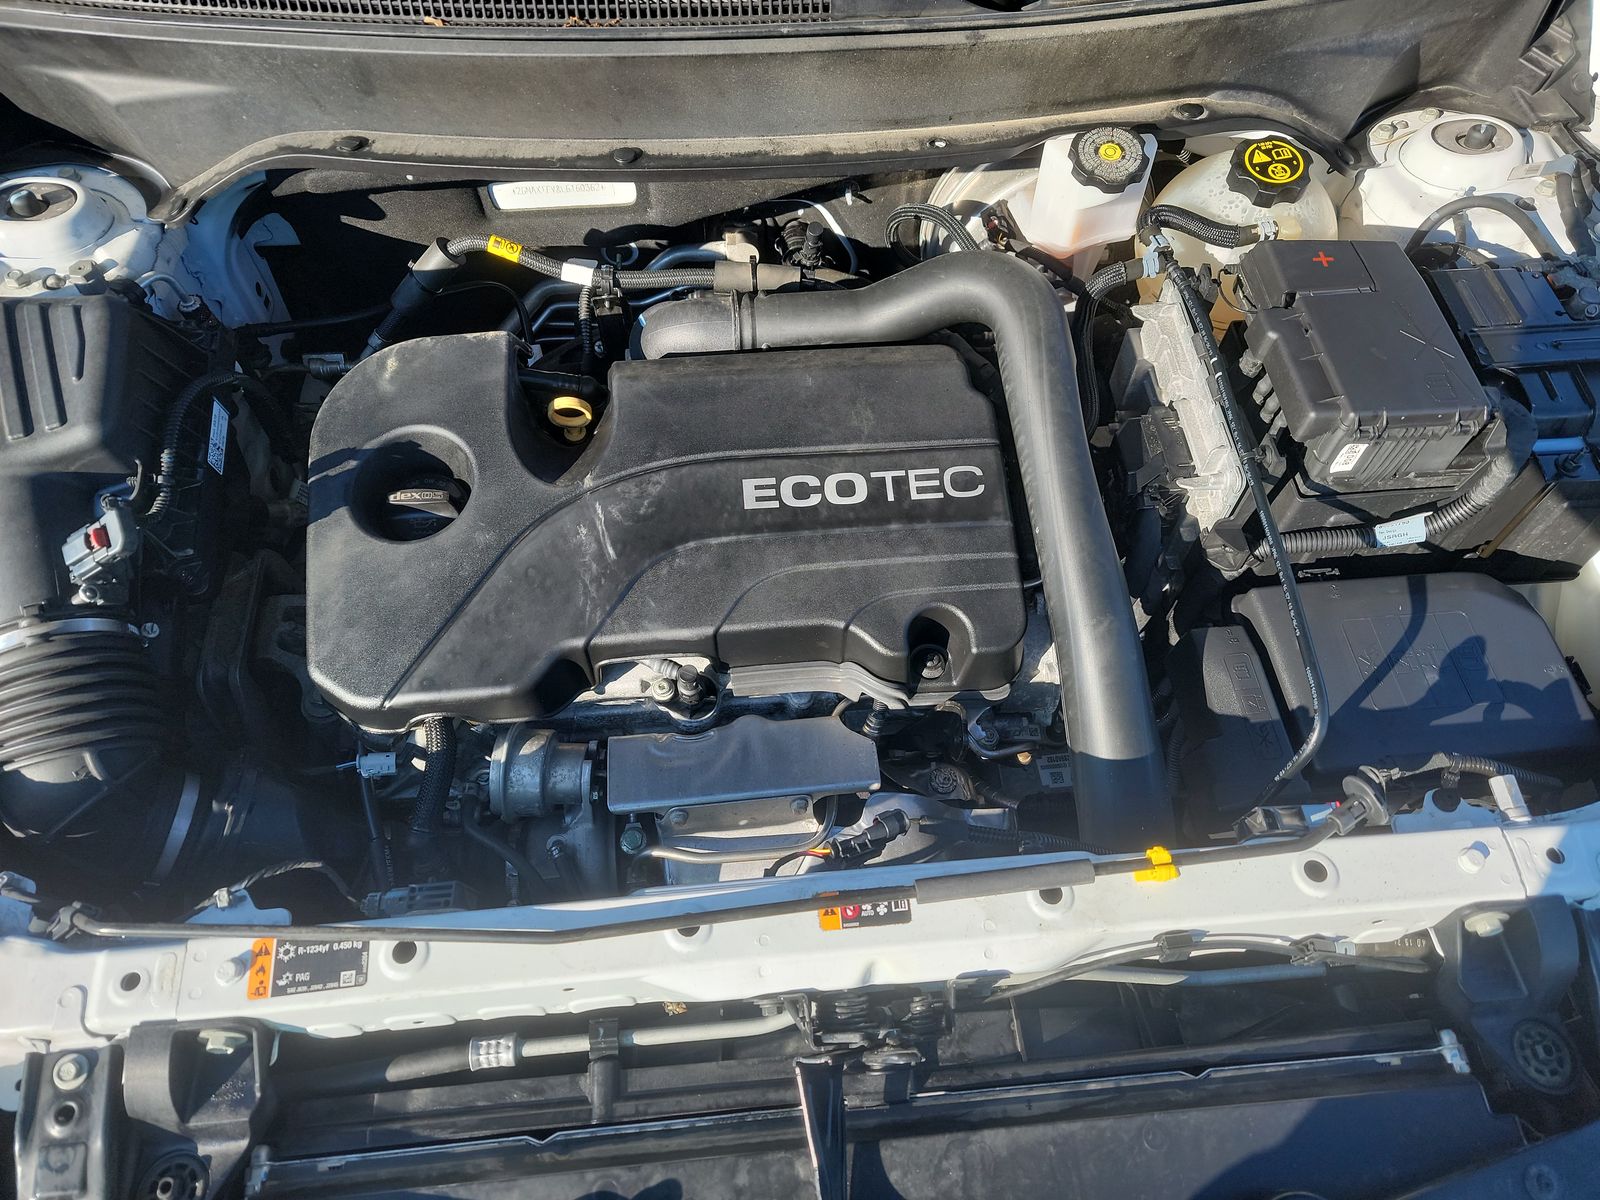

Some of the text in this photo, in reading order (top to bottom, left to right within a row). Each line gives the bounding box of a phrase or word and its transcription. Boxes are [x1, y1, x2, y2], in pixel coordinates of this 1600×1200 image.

[742, 465, 985, 510] ECOTEC
[388, 491, 444, 501] dexos
[297, 943, 330, 955] R-1234yf
[353, 940, 363, 950] kg
[295, 972, 310, 982] PAG
